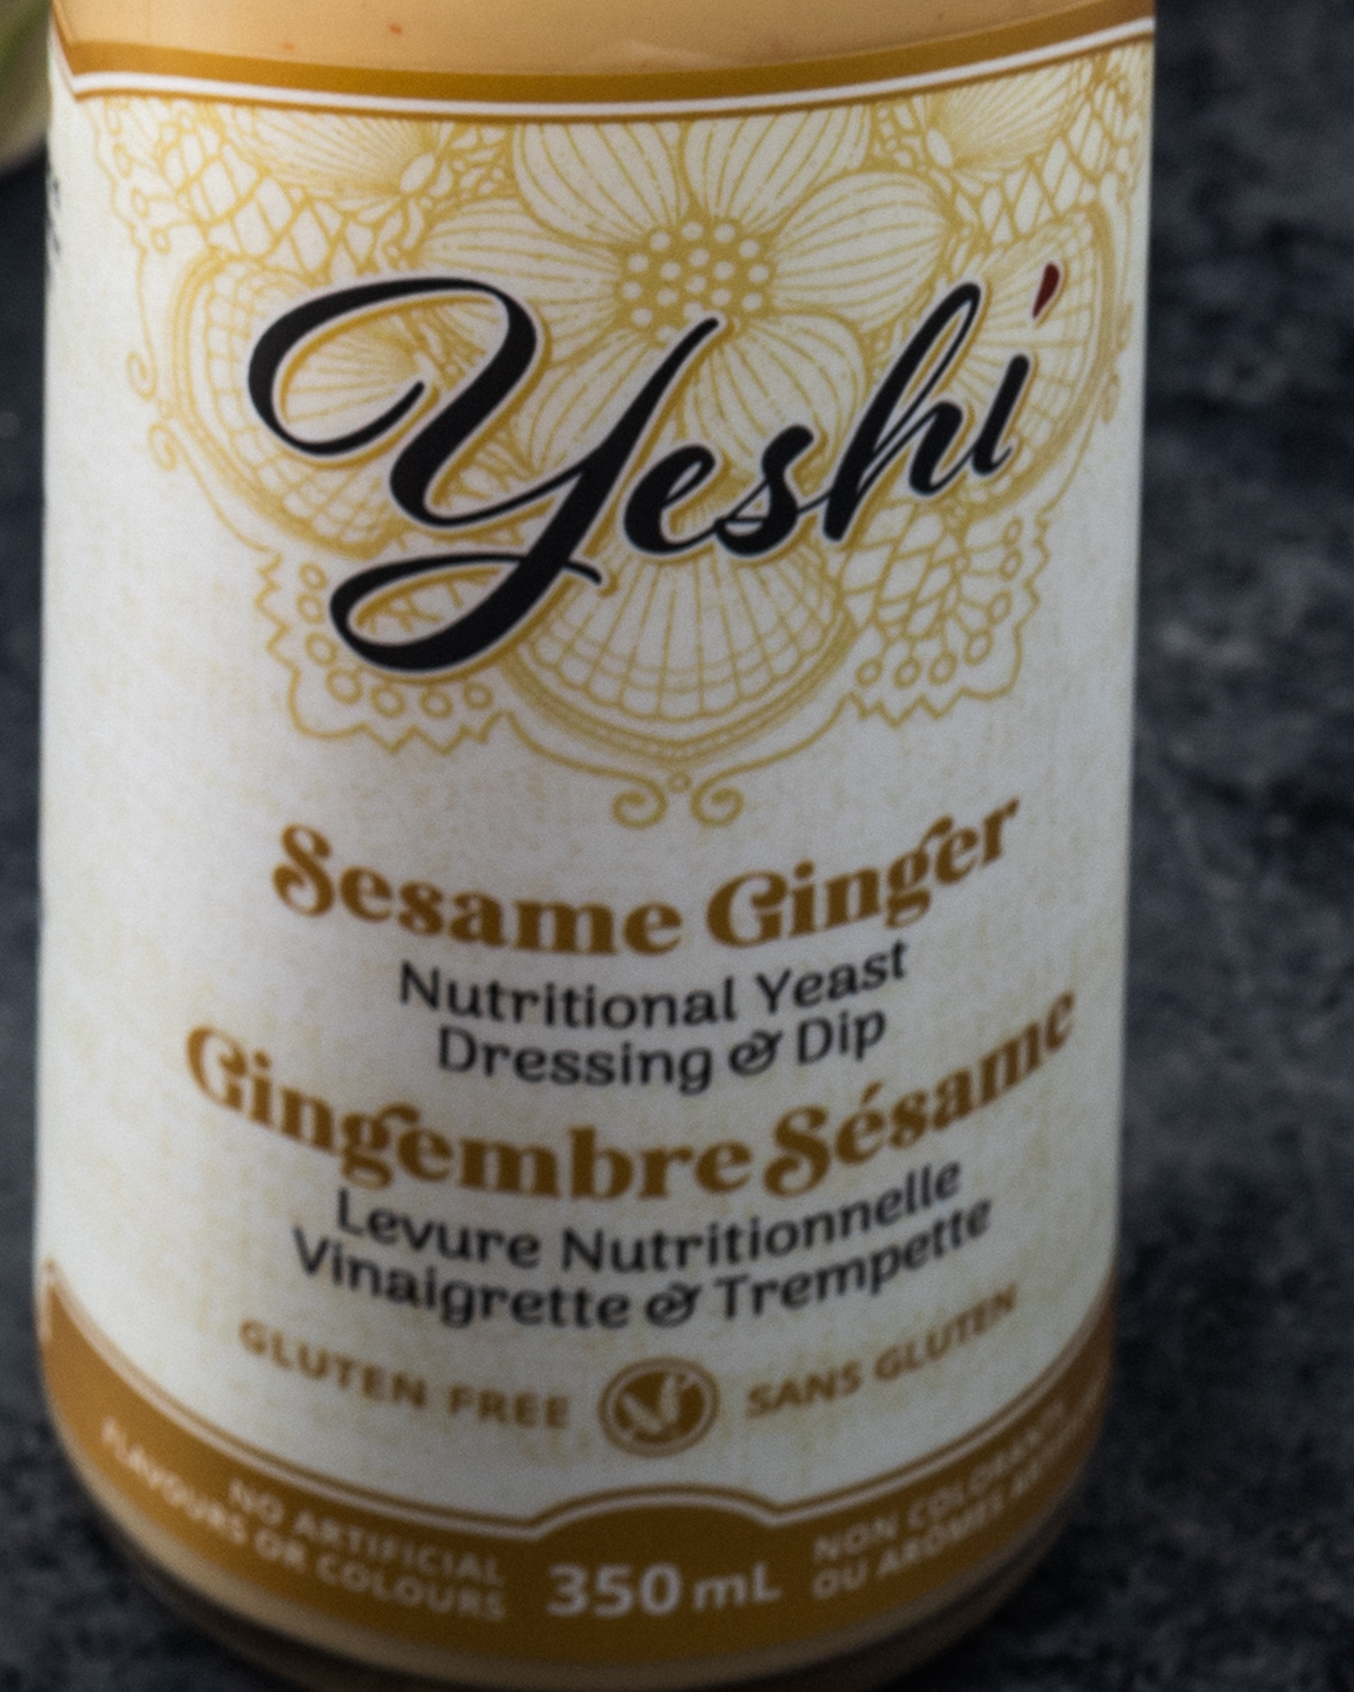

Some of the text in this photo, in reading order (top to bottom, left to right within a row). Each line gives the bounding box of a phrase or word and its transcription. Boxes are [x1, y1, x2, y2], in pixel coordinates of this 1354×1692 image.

[248, 263, 1060, 671] Yeshi
[271, 798, 1020, 956] Sesame Ginger
[399, 940, 907, 1031] Nutritional Yeast
[184, 990, 1076, 1200] Gingembre Sésame
[437, 1007, 887, 1095] Dressing & Dip
[293, 1196, 993, 1330] Vinaigrette & Trempette
[336, 1159, 961, 1274] Levure Nutritionnelle
[238, 1317, 570, 1429] GLUTEN FREE
[746, 1281, 1018, 1419] SANS GLUTEN
[229, 1479, 506, 1588] NO ARTIFICIAL
[254, 1529, 308, 1575] OR
[315, 1552, 508, 1623] COLOURS
[811, 1558, 869, 1601] OU
[812, 1511, 899, 1564] NON
[546, 1560, 783, 1619] 350 mL
